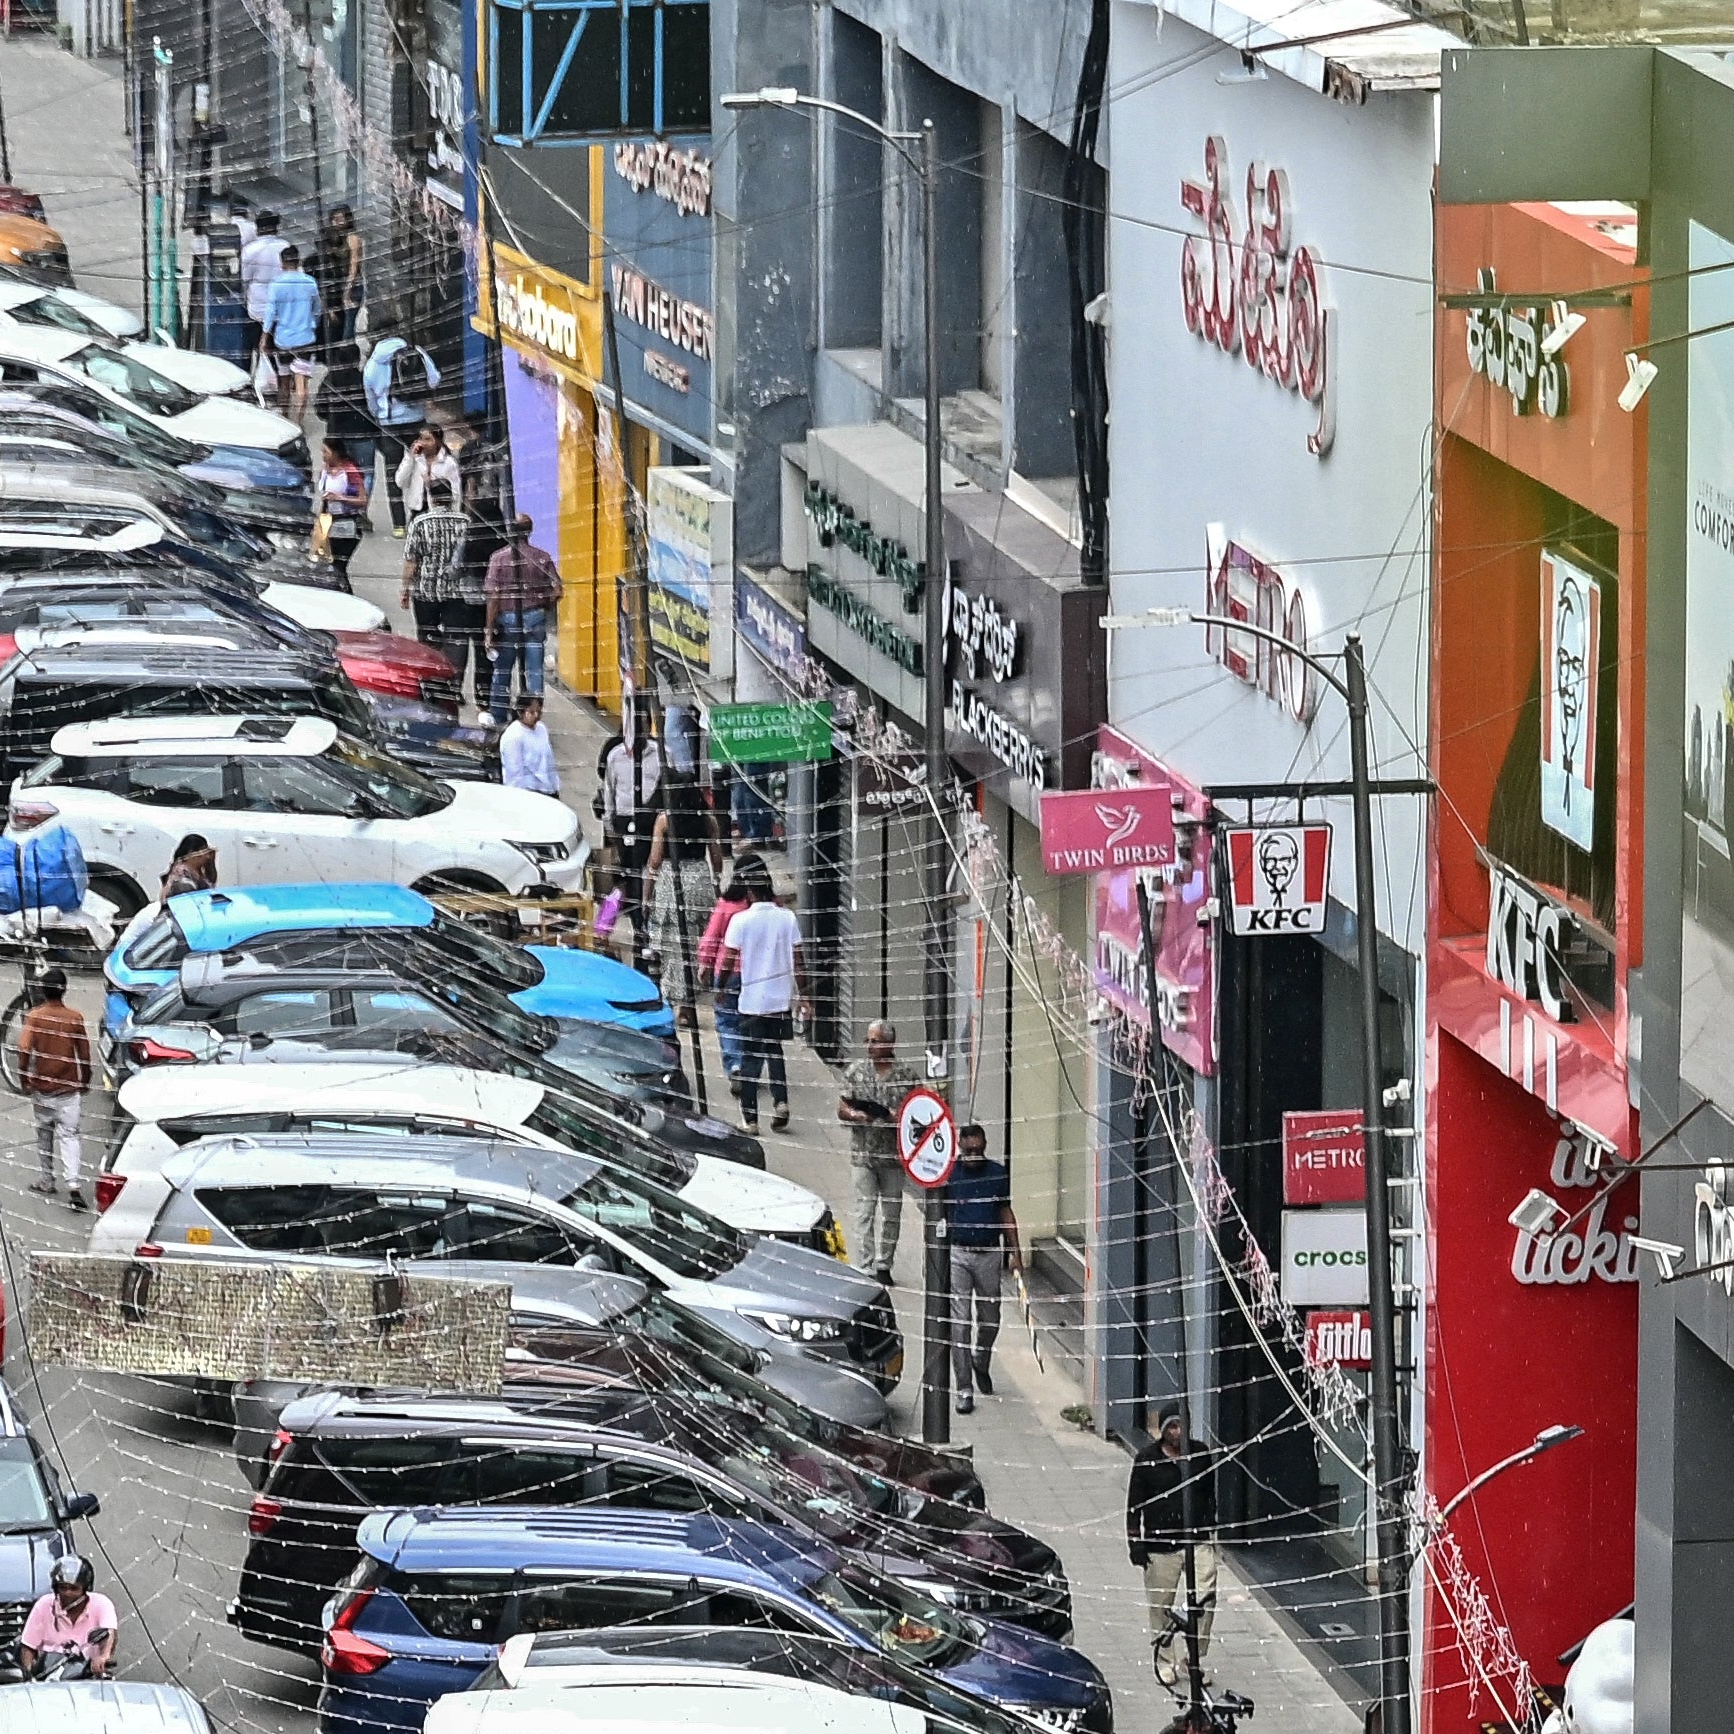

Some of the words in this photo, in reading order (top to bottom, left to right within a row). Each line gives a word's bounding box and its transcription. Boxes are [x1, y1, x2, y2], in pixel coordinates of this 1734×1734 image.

[610, 263, 645, 326] VAN
[952, 678, 1044, 790] BLACKBERRYS
[1050, 849, 1105, 869] TWIN
[1112, 843, 1169, 865] BIRDS
[1246, 907, 1313, 932] KFC
[1486, 864, 1569, 1023] KFC
[1293, 1250, 1366, 1267] crocs
